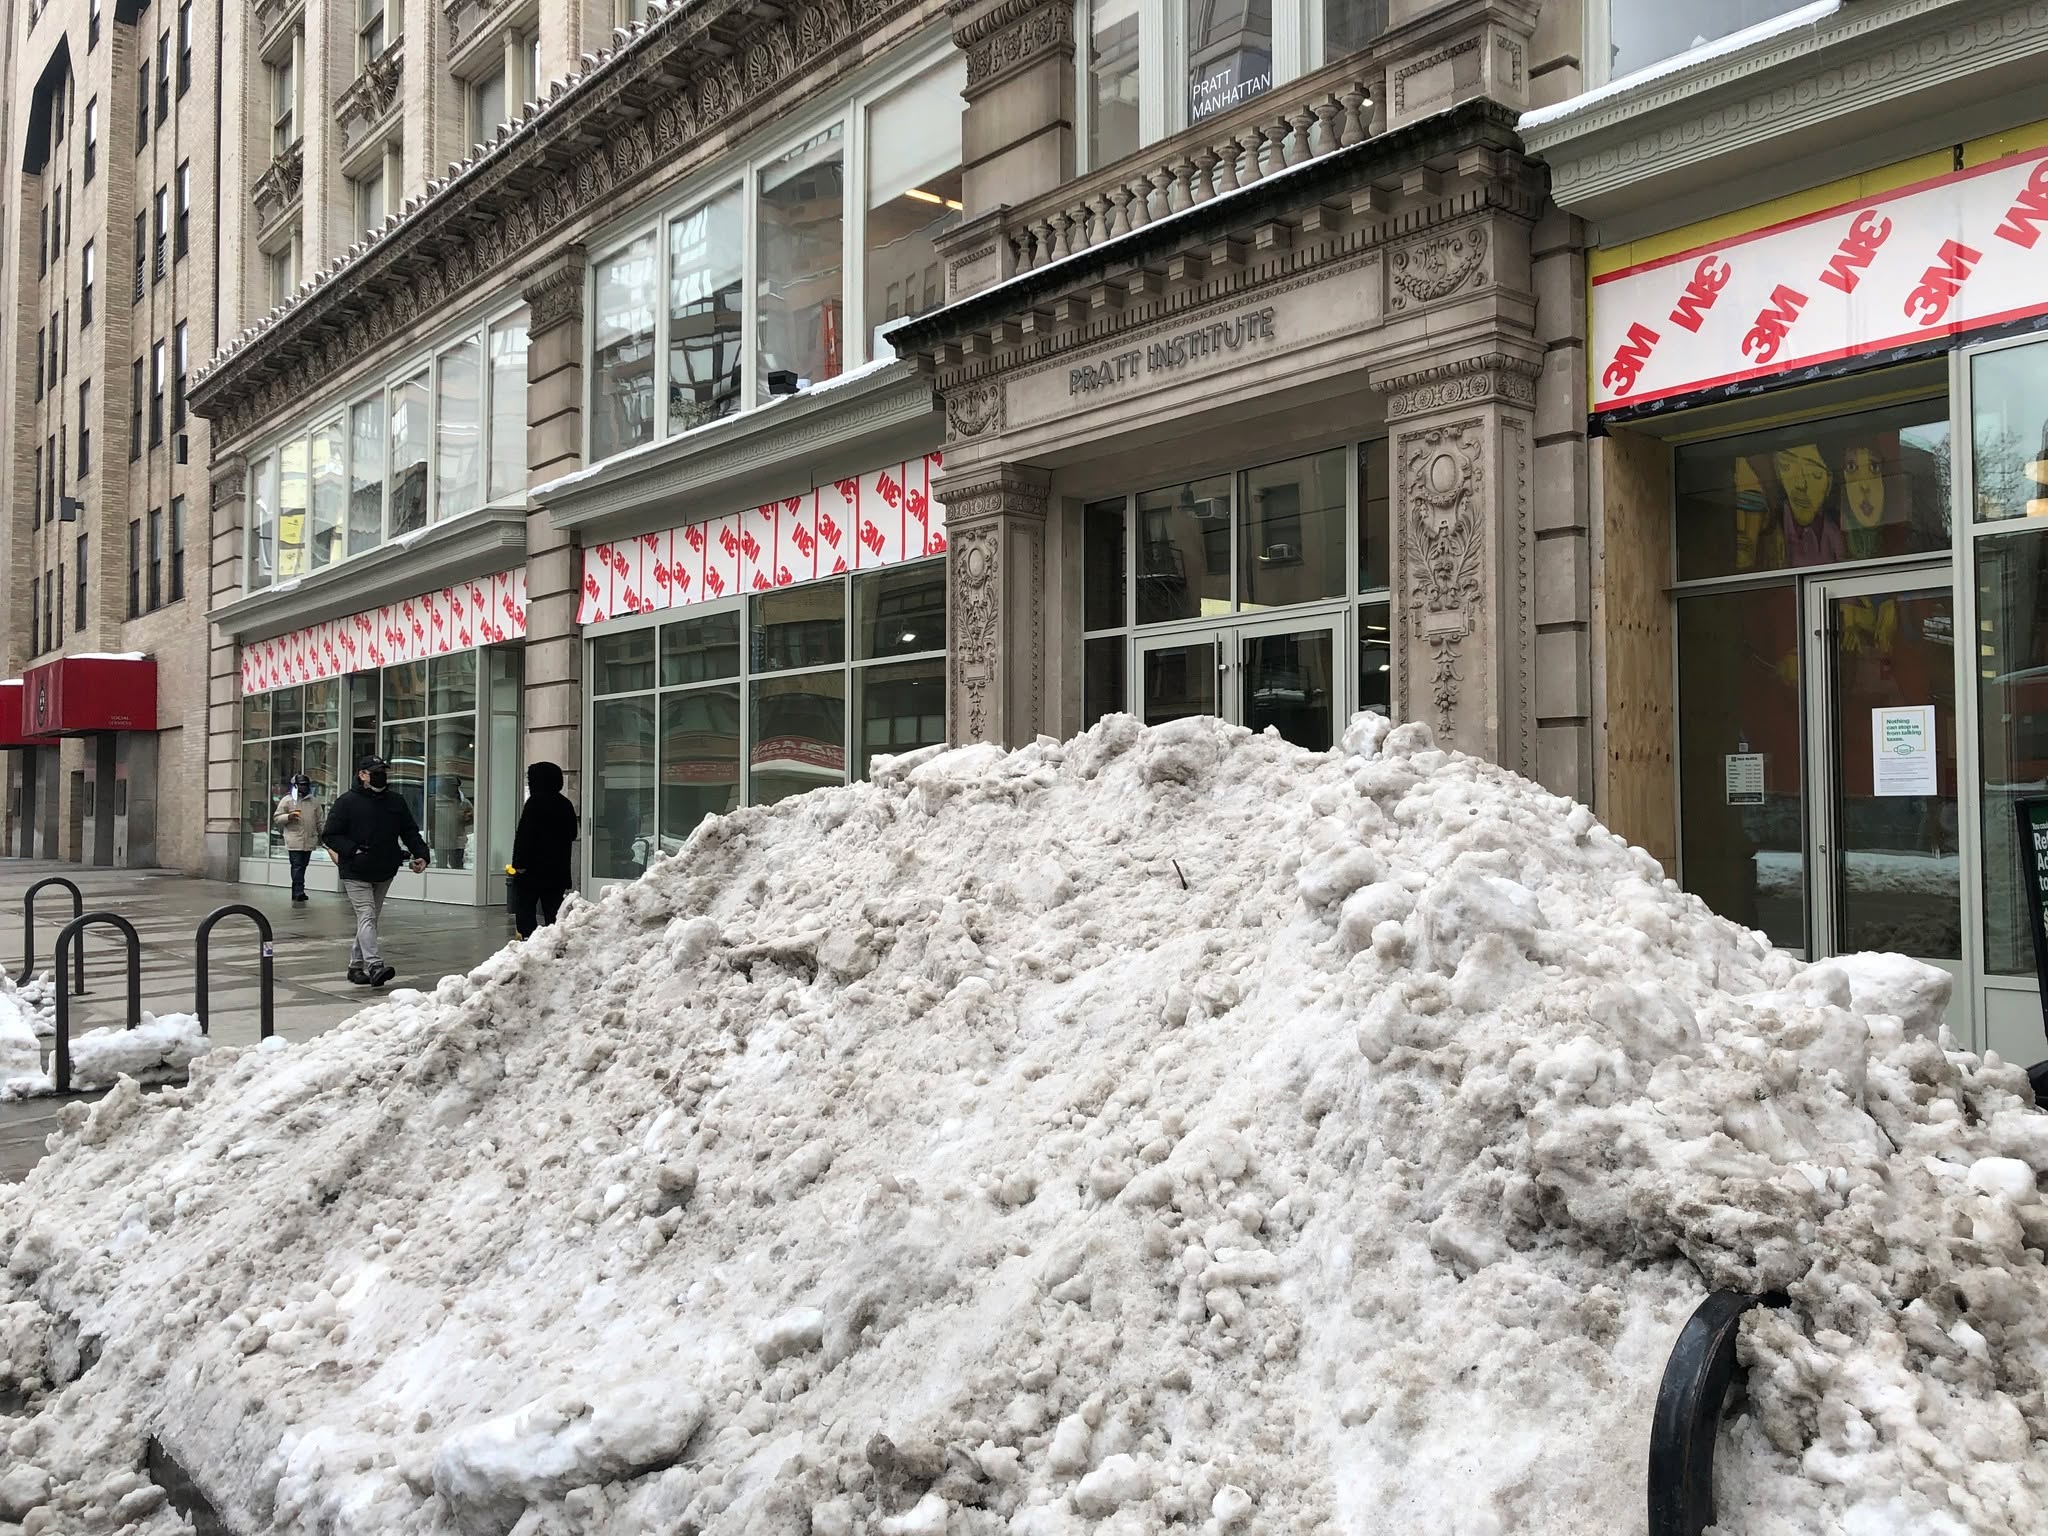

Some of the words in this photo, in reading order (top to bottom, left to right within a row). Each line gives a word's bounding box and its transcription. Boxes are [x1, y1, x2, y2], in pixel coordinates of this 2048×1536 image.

[1193, 69, 1231, 100] PRATT
[1193, 72, 1271, 120] MANHATTAN
[1818, 210, 1892, 294] 3M
[1669, 256, 1731, 333] 3M
[1904, 239, 1983, 326] 3M
[1741, 284, 1809, 364] 3M
[1069, 349, 1141, 396] PRATT
[1147, 306, 1275, 373] INSTITUTE
[1602, 322, 1660, 397] 3M
[876, 471, 901, 508] 3M
[685, 525, 703, 553] 3M
[719, 525, 739, 558] 3M
[742, 530, 761, 564] 3M
[792, 522, 814, 557] 3M
[819, 513, 842, 550] 3M
[860, 520, 886, 557] 3M
[614, 551, 630, 580] 3M
[674, 561, 691, 593] 3M
[707, 565, 725, 599] 3M
[585, 574, 600, 602] 3M
